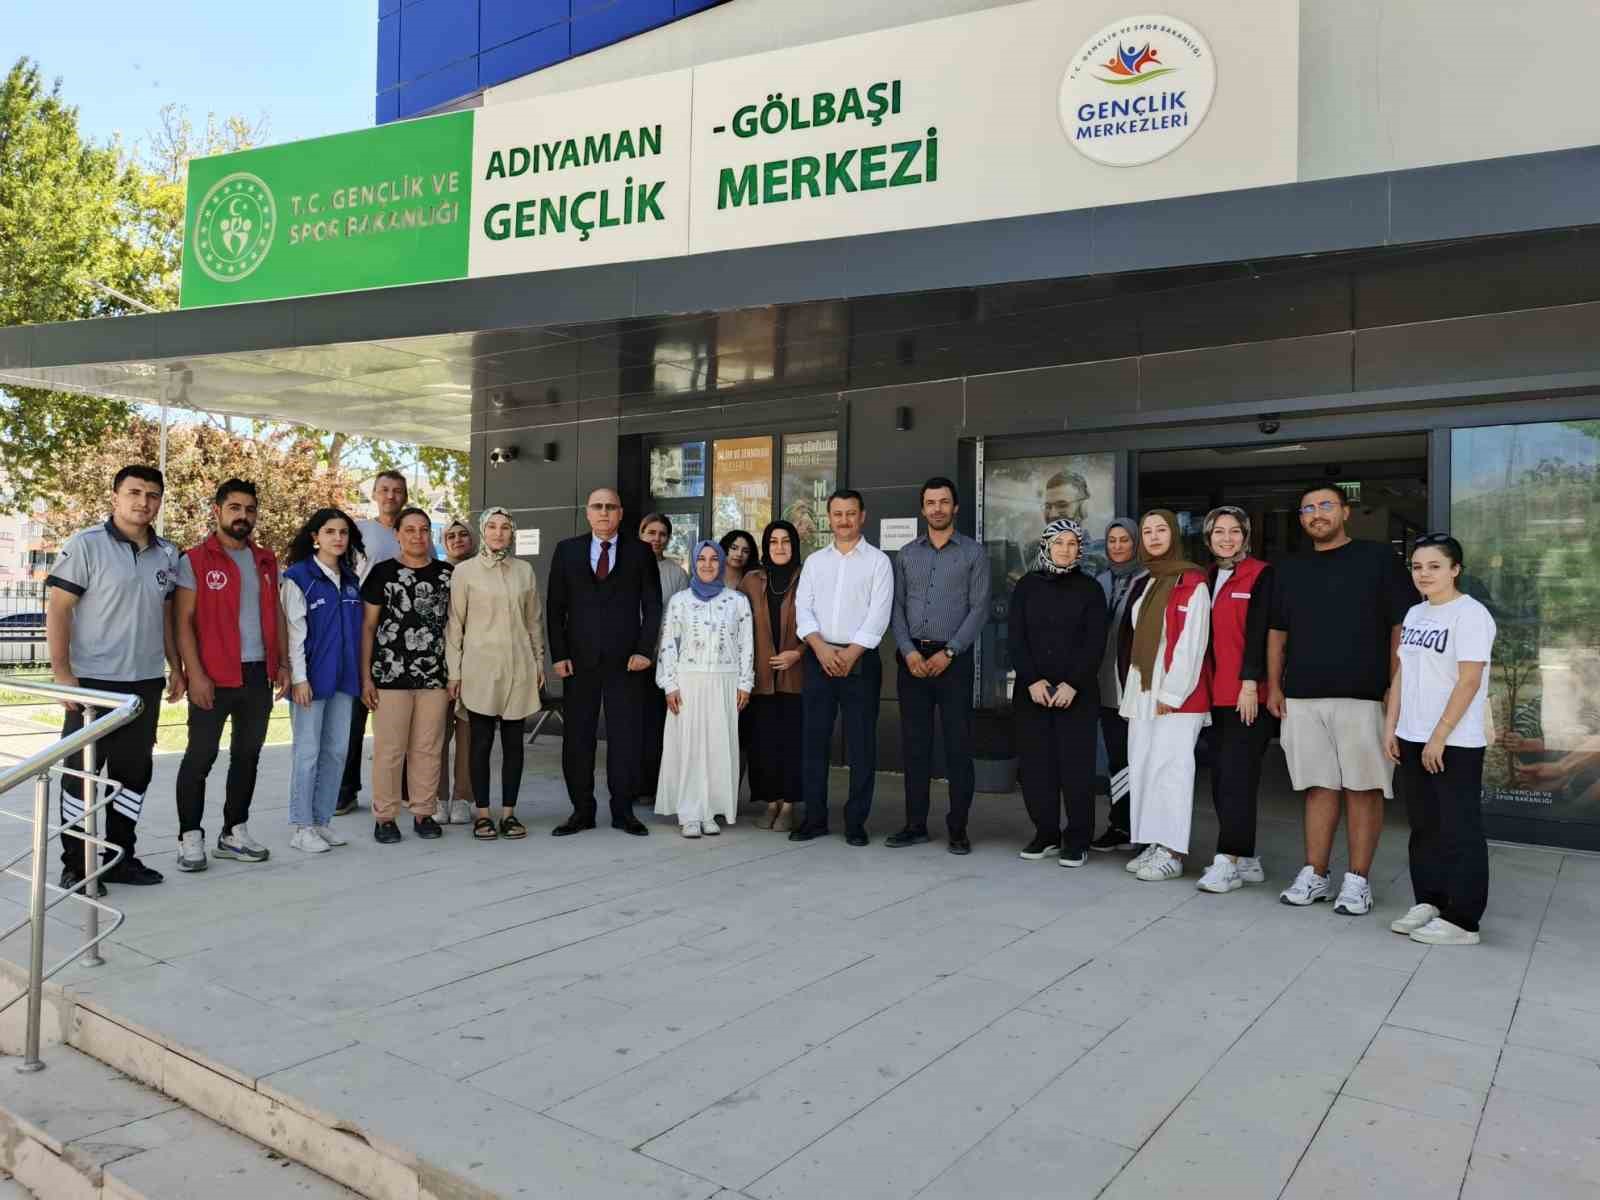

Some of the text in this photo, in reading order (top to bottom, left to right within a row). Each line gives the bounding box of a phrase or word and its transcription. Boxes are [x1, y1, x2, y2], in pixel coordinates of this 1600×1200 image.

[1076, 112, 1188, 140] MERKEZLERİ
[1077, 90, 1187, 121] GENÇLİK
[485, 124, 662, 180] ADIYAMAN
[291, 171, 460, 216] T.C. GENÇLİK VE
[483, 126, 938, 242] GENÇLİK MERKEZİ
[288, 200, 460, 245] SPOR BAKANLIĞI
